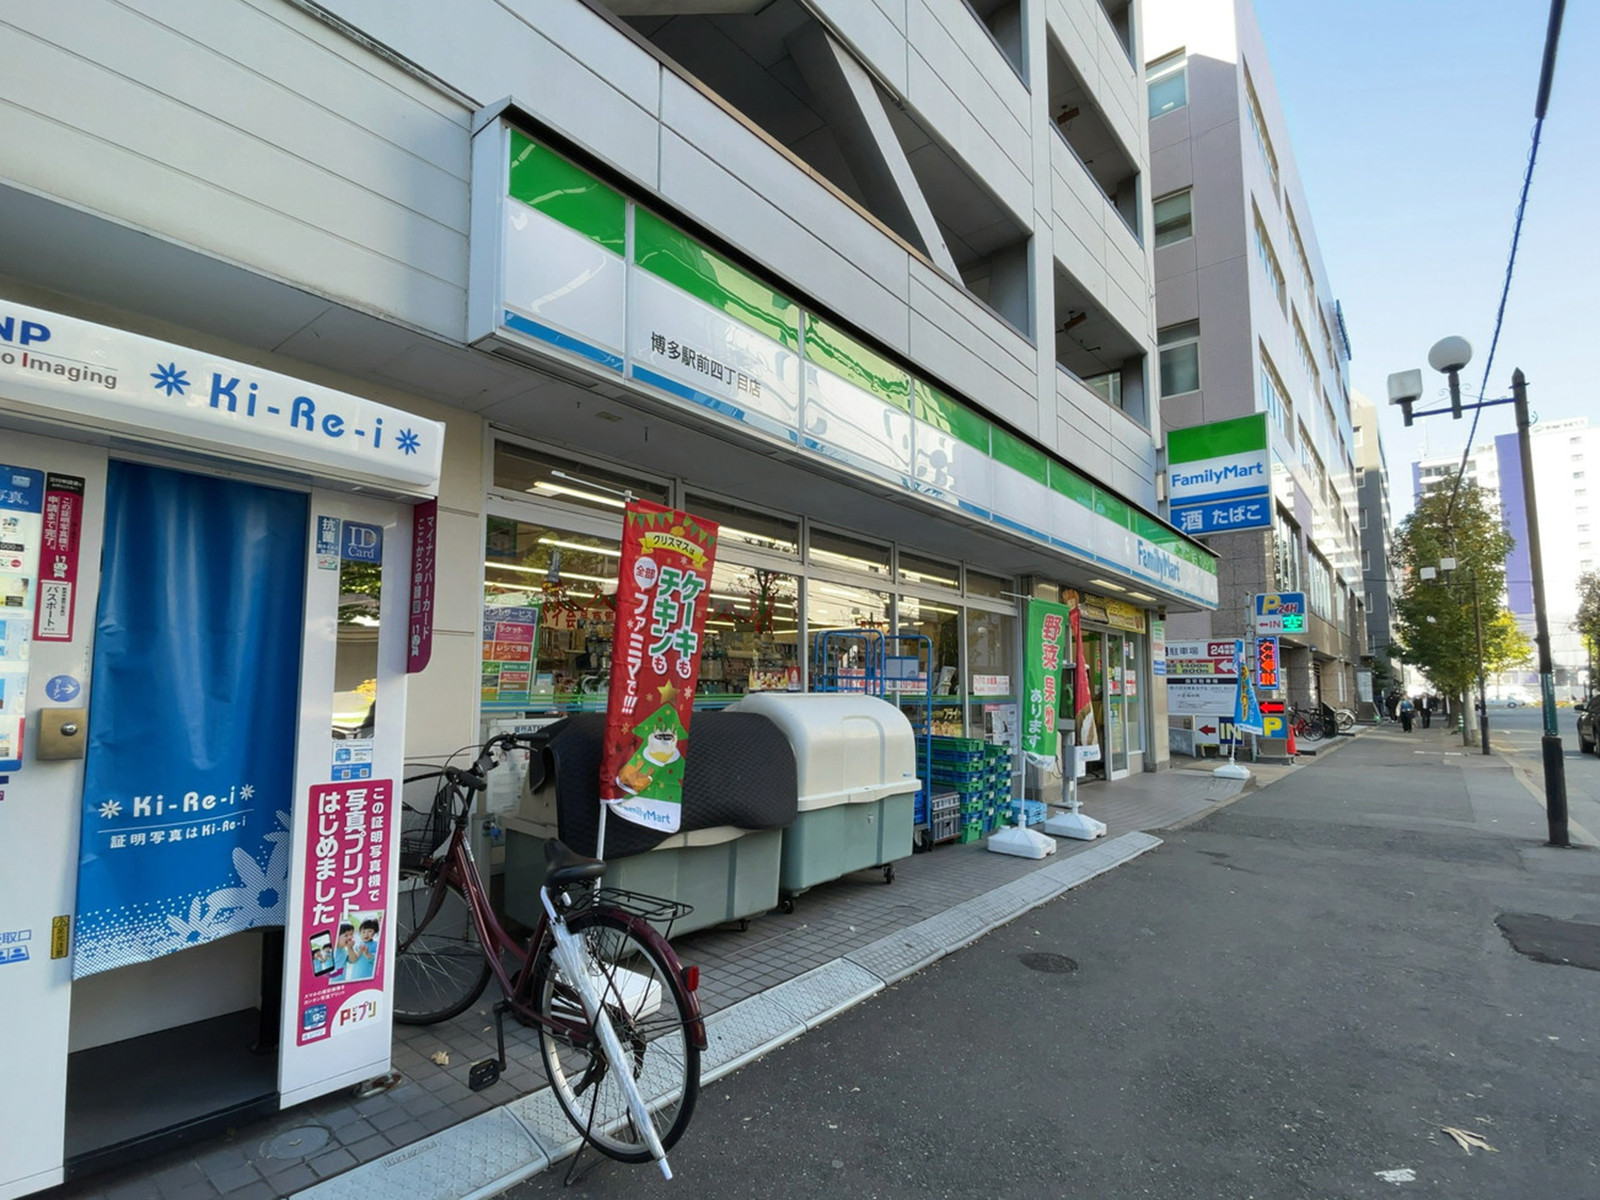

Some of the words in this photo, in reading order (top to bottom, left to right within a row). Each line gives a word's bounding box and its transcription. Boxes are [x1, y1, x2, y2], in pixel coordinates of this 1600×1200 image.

[22, 352, 117, 390] Imaging
[651, 331, 761, 398] 博多駅前四丁目店
[209, 373, 383, 448] Ki-Re-i
[1171, 462, 1263, 487] FamilyMart
[322, 518, 335, 543] 抗菌
[1181, 510, 1203, 531] 酒
[1212, 505, 1261, 525] たばこ
[348, 546, 375, 559] Card
[349, 526, 377, 548] ID
[653, 534, 695, 556] クリスマスは
[422, 516, 435, 640] マイナンバーカード
[636, 565, 656, 582] 全部
[1137, 540, 1181, 582] FamilyMart
[649, 567, 682, 674] チキンも
[1262, 594, 1281, 615] P
[1279, 603, 1298, 614] 24H
[674, 570, 705, 677] ケーキも
[1042, 613, 1062, 669] 野菜
[1028, 688, 1042, 748] あります
[1220, 722, 1242, 740] IN
[1264, 717, 1282, 736] P
[133, 785, 235, 817] Ki-Re-i
[110, 826, 198, 849] 証明写真は
[202, 815, 246, 837] Ki-Re-i
[368, 787, 384, 902] この証明写真機で
[313, 791, 341, 926] はじめました
[341, 788, 367, 920] 写真プリント
